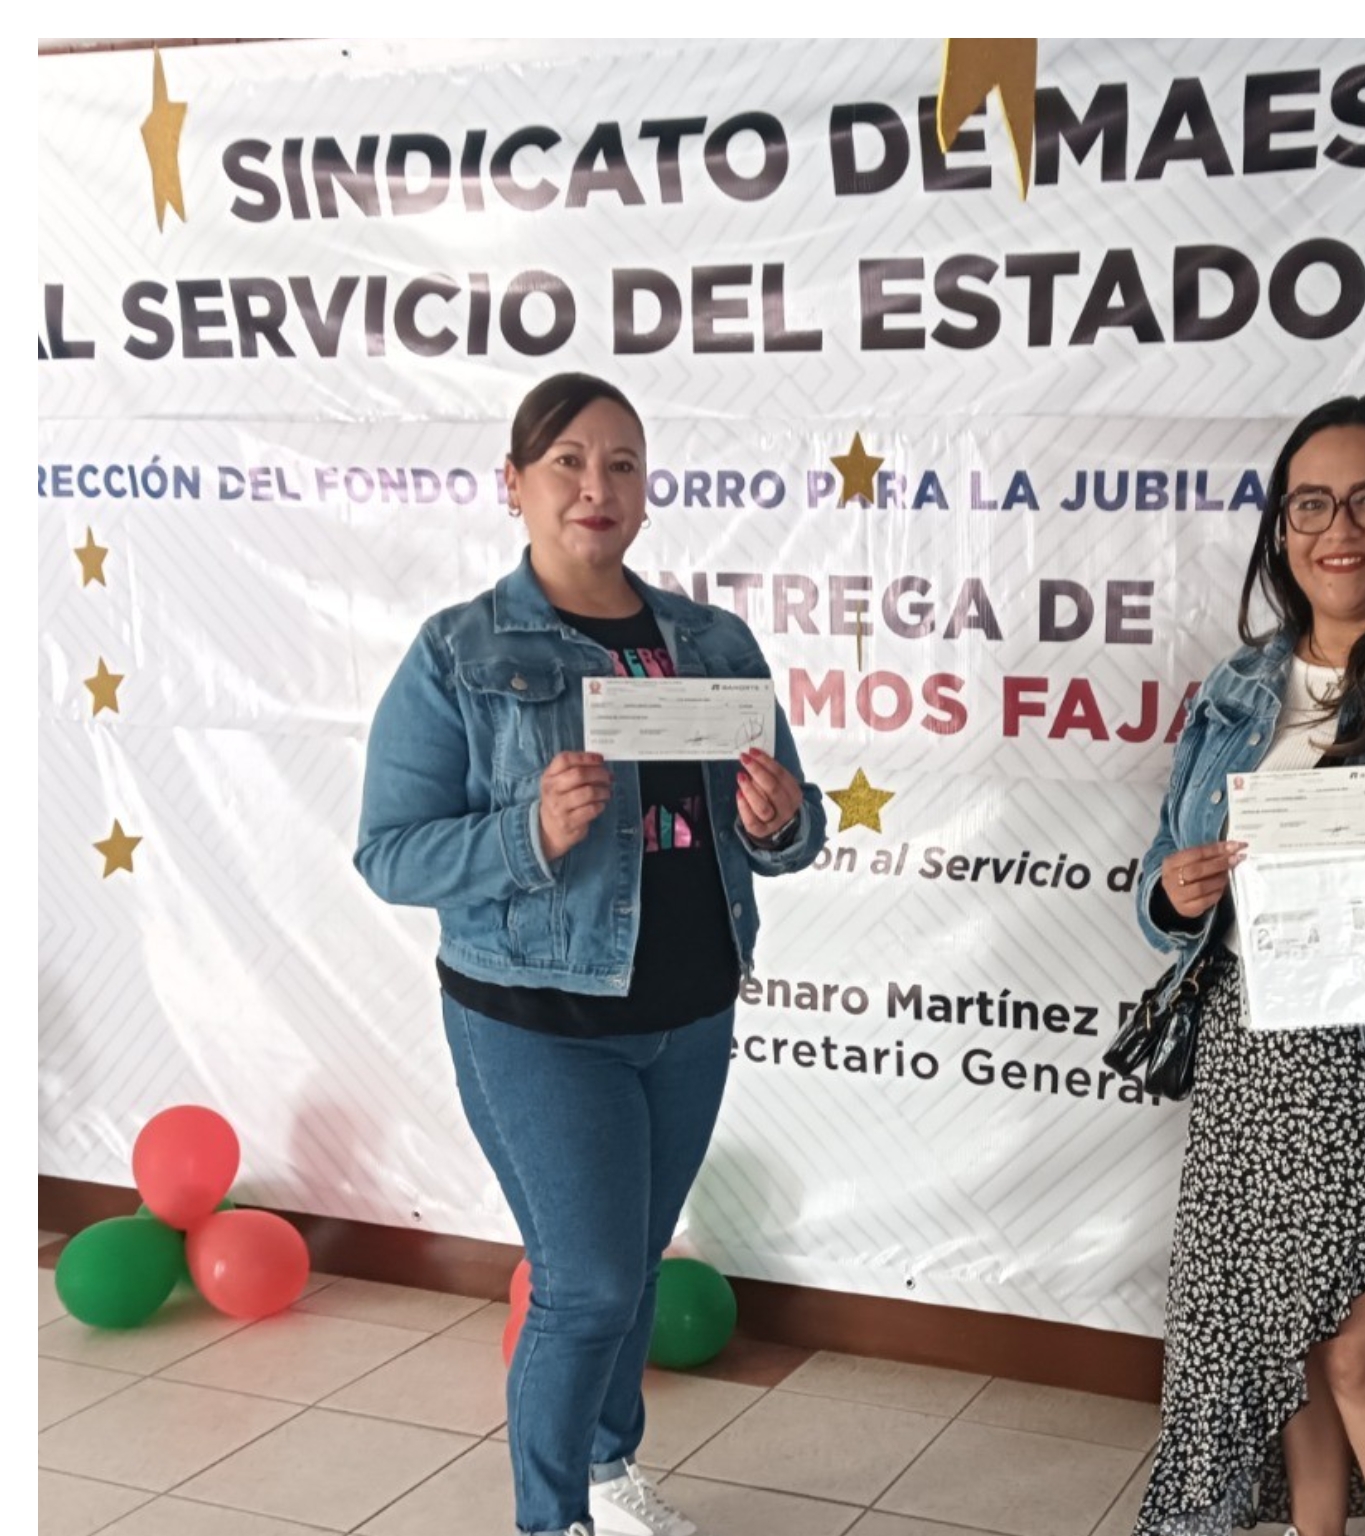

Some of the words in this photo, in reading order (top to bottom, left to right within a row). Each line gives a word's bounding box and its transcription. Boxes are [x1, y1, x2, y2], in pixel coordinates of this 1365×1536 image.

[221, 110, 790, 223] SINDICATO
[830, 96, 992, 196] DE
[38, 283, 95, 360] L
[122, 270, 578, 360] SERVICIO
[613, 263, 823, 356] DEL
[217, 466, 301, 501] DEL
[315, 467, 478, 506] FONDO
[646, 469, 787, 509] ORRO
[970, 469, 1040, 512] LA
[1060, 469, 1266, 512] JUBILA
[641, 571, 1003, 641] NTREGA
[1039, 579, 1155, 645] DE
[869, 842, 910, 876] al
[918, 845, 1092, 890] Servicio
[1107, 858, 1143, 893] d
[740, 975, 870, 1015] enaro
[887, 981, 1099, 1036] Martínez
[730, 1033, 939, 1080] cretario
[962, 1048, 1160, 1107] Genera
